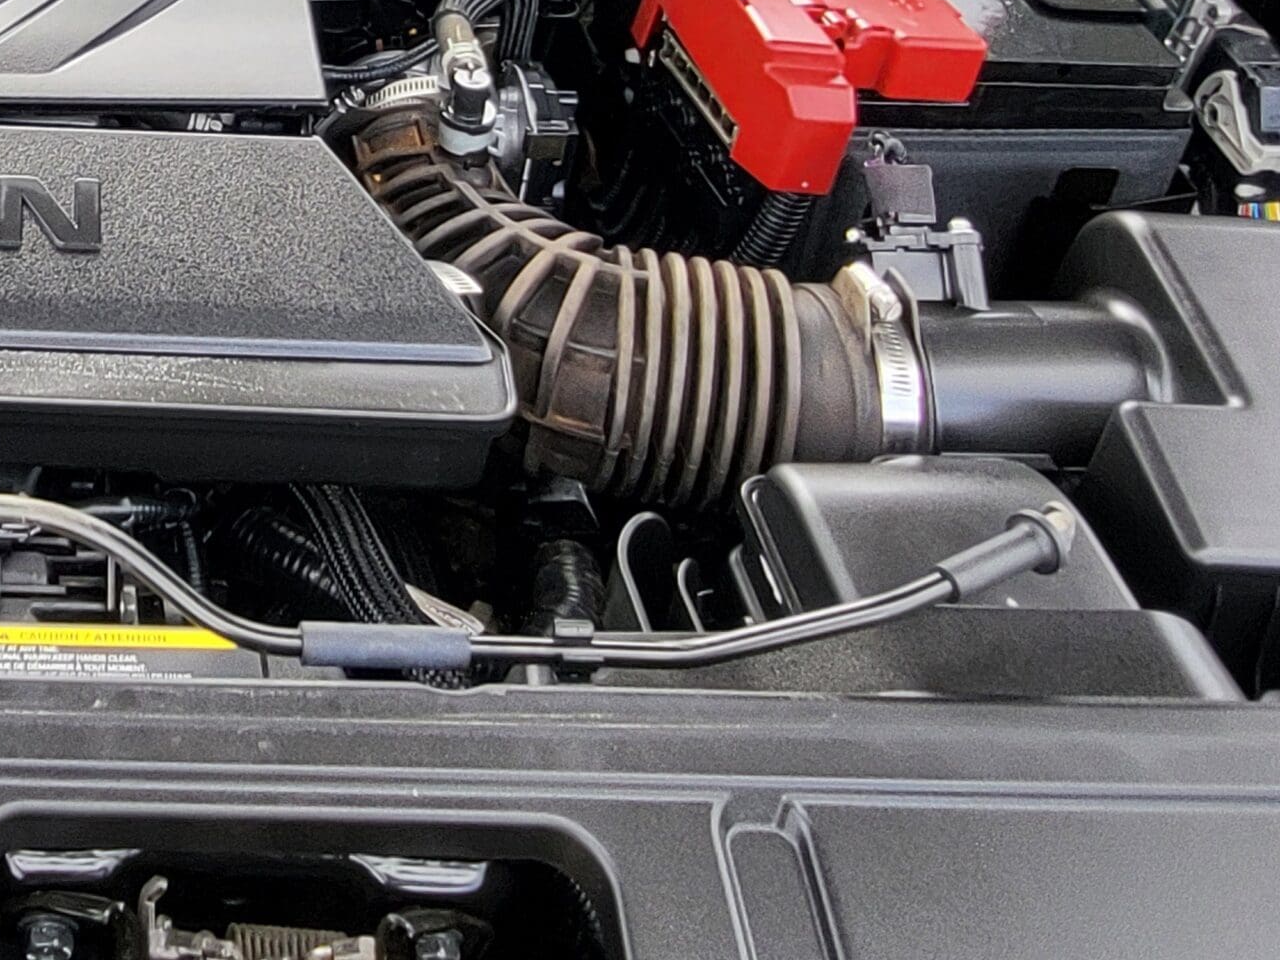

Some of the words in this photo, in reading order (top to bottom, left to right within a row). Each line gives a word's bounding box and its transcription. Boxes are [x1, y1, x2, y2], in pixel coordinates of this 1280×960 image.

[19, 631, 79, 641] CAUTION
[94, 632, 167, 643] ATTENTION
[75, 653, 107, 662] HANDS
[13, 662, 25, 670] DE
[83, 663, 106, 672] TOUT
